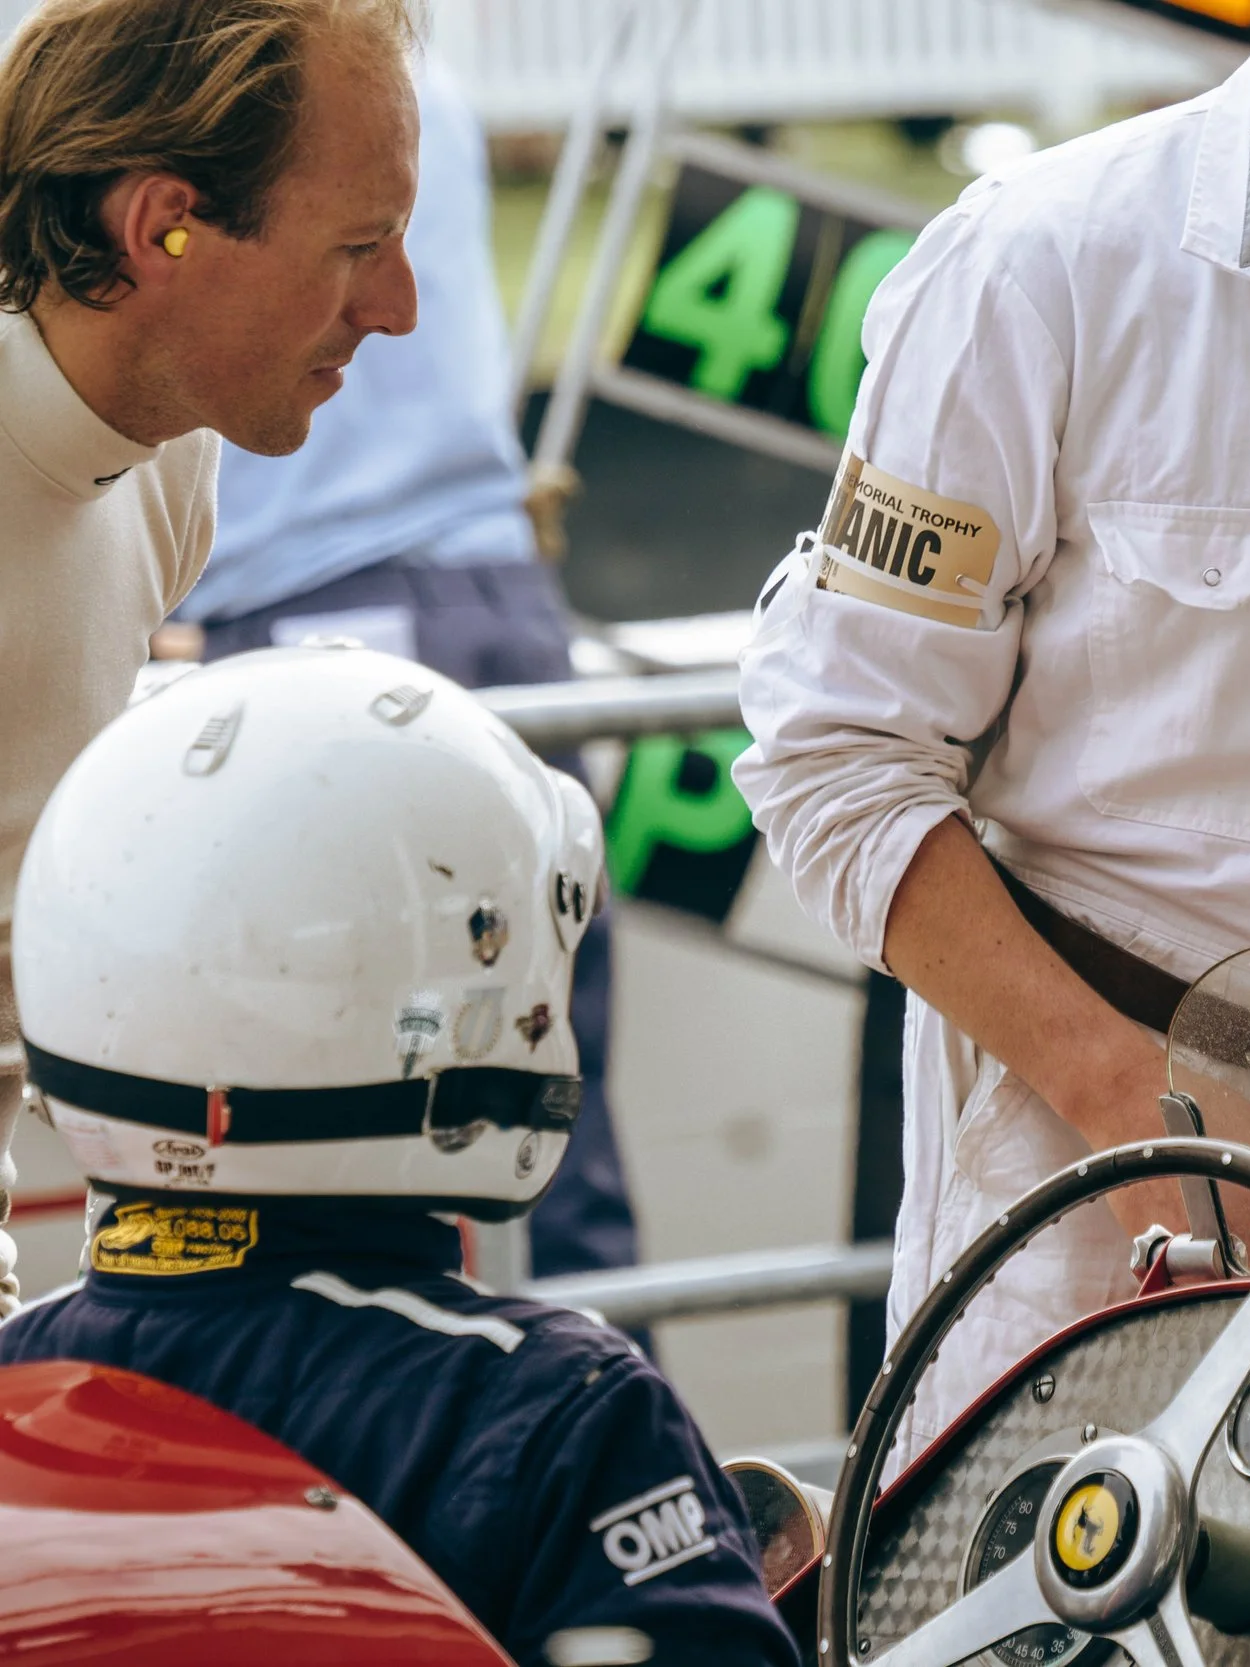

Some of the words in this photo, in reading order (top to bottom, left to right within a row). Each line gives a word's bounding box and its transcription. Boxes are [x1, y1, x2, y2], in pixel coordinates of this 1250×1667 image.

[846, 471, 905, 514] EMORIAL
[910, 503, 984, 538] TROPHY
[832, 498, 942, 587] ANIC
[1018, 1501, 1033, 1515] 80
[602, 1491, 706, 1571] OMP
[1004, 1521, 1018, 1535] 75
[993, 1546, 1006, 1560] 70
[1014, 1644, 1028, 1658] 45
[1050, 1639, 1065, 1654] 35
[1030, 1647, 1045, 1661] 40
